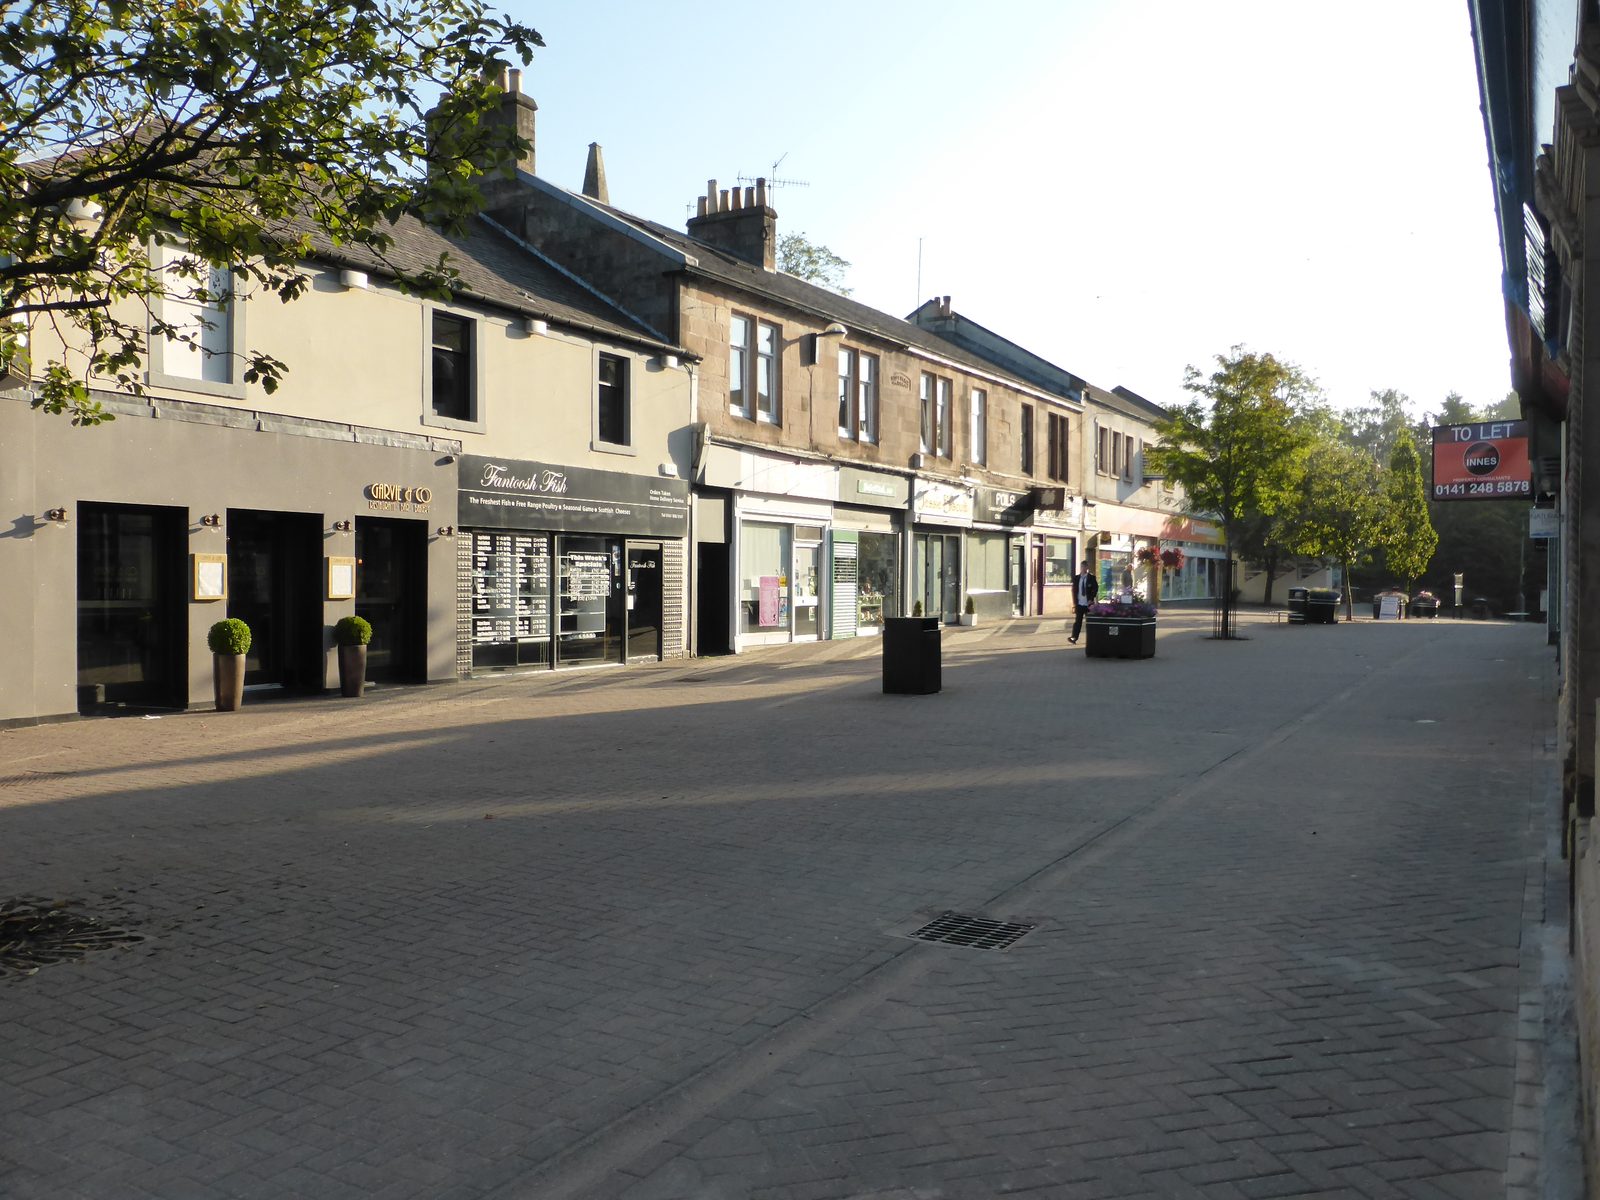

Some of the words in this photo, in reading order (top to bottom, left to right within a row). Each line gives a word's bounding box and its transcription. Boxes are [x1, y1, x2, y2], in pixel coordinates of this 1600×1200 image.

[1451, 427, 1472, 441] TO
[1480, 423, 1514, 440] LET
[1466, 457, 1497, 467] INNES
[481, 463, 538, 491] Fantoosh
[539, 469, 568, 493] Fish
[371, 483, 402, 501] GARVIE
[405, 486, 412, 501] &
[415, 487, 432, 503] CO
[1436, 484, 1465, 495] 0141
[1470, 483, 1493, 494] 248
[1497, 481, 1529, 492] 5878
[469, 496, 479, 504] The
[480, 497, 500, 505] Freshest
[527, 502, 541, 510] Range
[542, 503, 558, 511] Poultry
[562, 504, 581, 512] Seasonal
[598, 506, 613, 514] Scottish
